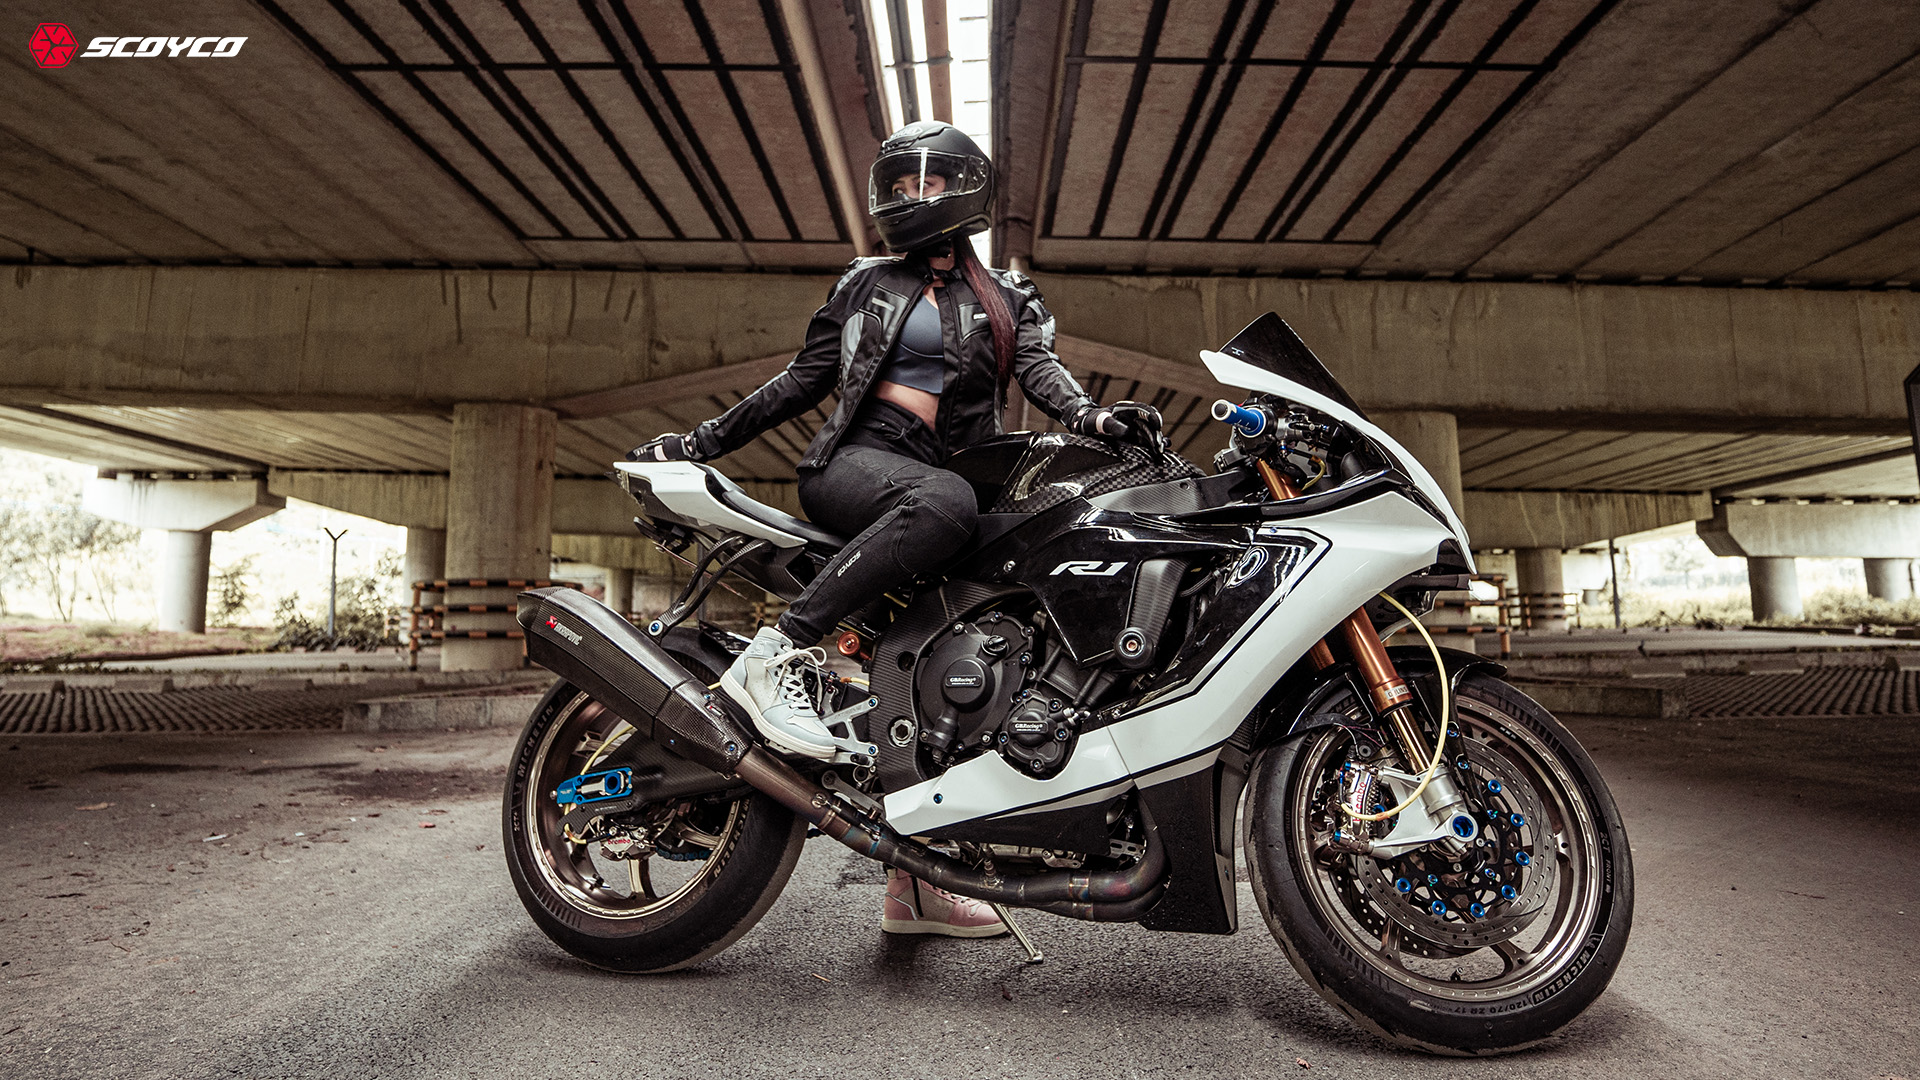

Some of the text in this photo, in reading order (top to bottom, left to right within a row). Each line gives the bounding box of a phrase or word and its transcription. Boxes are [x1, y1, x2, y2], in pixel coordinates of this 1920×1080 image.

[1048, 561, 1129, 576] R1
[516, 704, 554, 778] MICHELIN
[713, 799, 750, 878] MICHELIN
[1600, 832, 1612, 884] 2CT FRONT
[1533, 949, 1591, 1003] MICHELIN
[1454, 1001, 1528, 1015] 120/70 ZR 17
